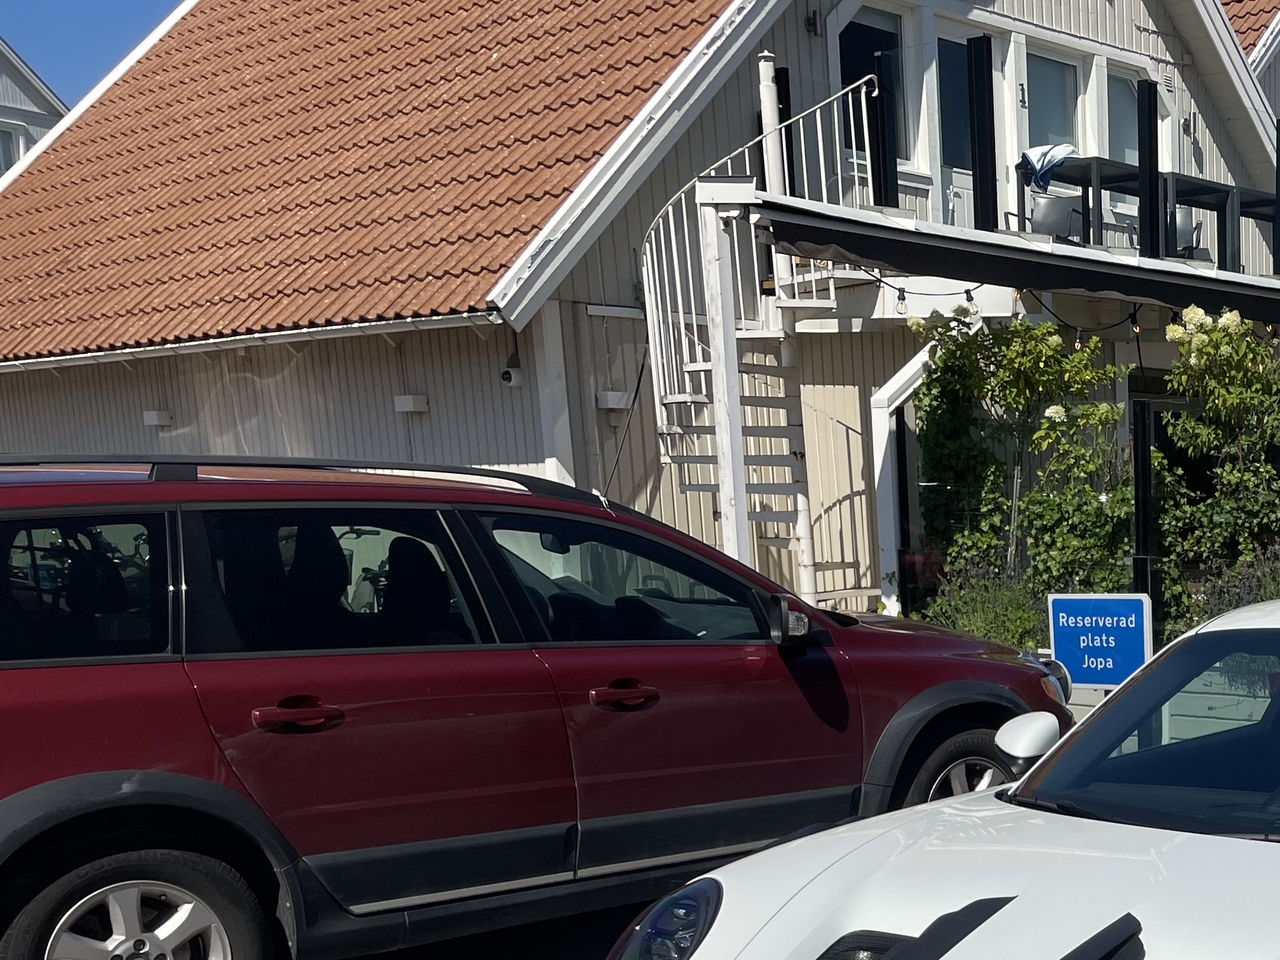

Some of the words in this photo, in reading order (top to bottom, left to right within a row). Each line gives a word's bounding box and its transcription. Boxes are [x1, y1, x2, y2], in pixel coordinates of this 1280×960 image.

[1059, 612, 1136, 628] Reserverad
[1080, 632, 1116, 649] plats
[1082, 654, 1113, 671] Jopa
